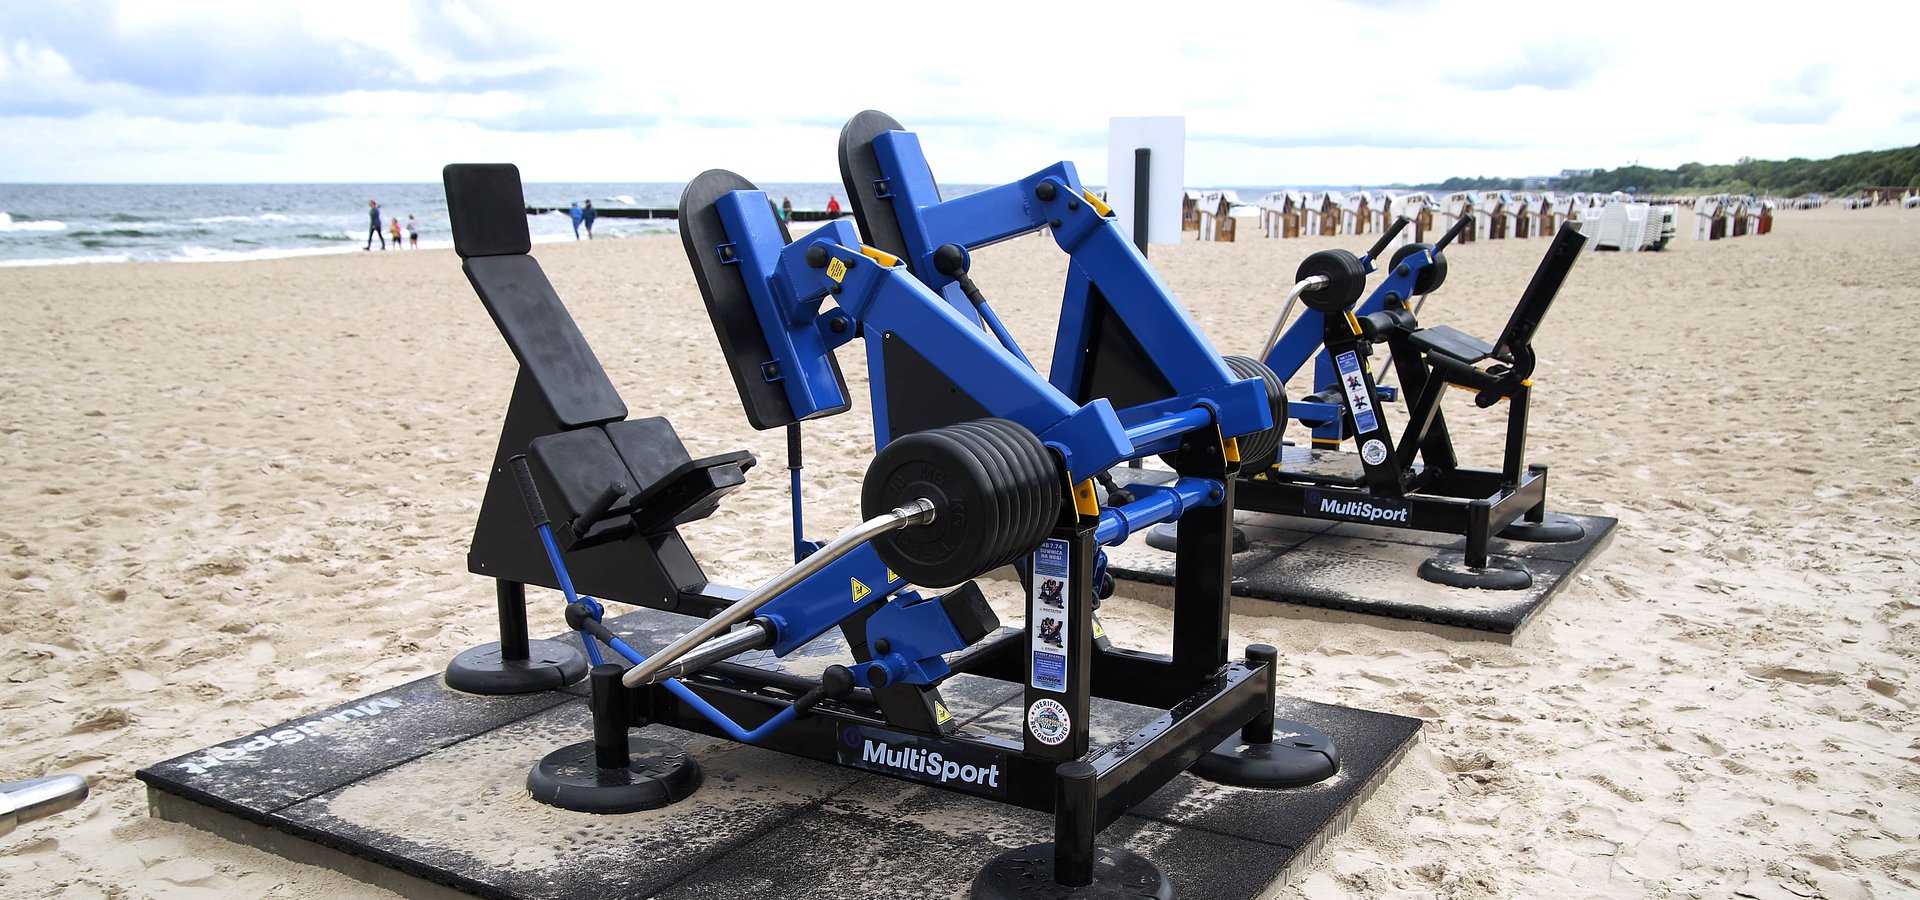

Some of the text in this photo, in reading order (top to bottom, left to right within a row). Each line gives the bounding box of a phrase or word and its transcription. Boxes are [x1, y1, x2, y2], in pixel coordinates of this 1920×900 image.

[1320, 498, 1408, 522] MultiSport
[1035, 700, 1064, 714] VERIFIED
[176, 697, 403, 775] MuiSport
[1030, 720, 1069, 744] RECOMMENDED
[862, 739, 1000, 788] MultiSport
